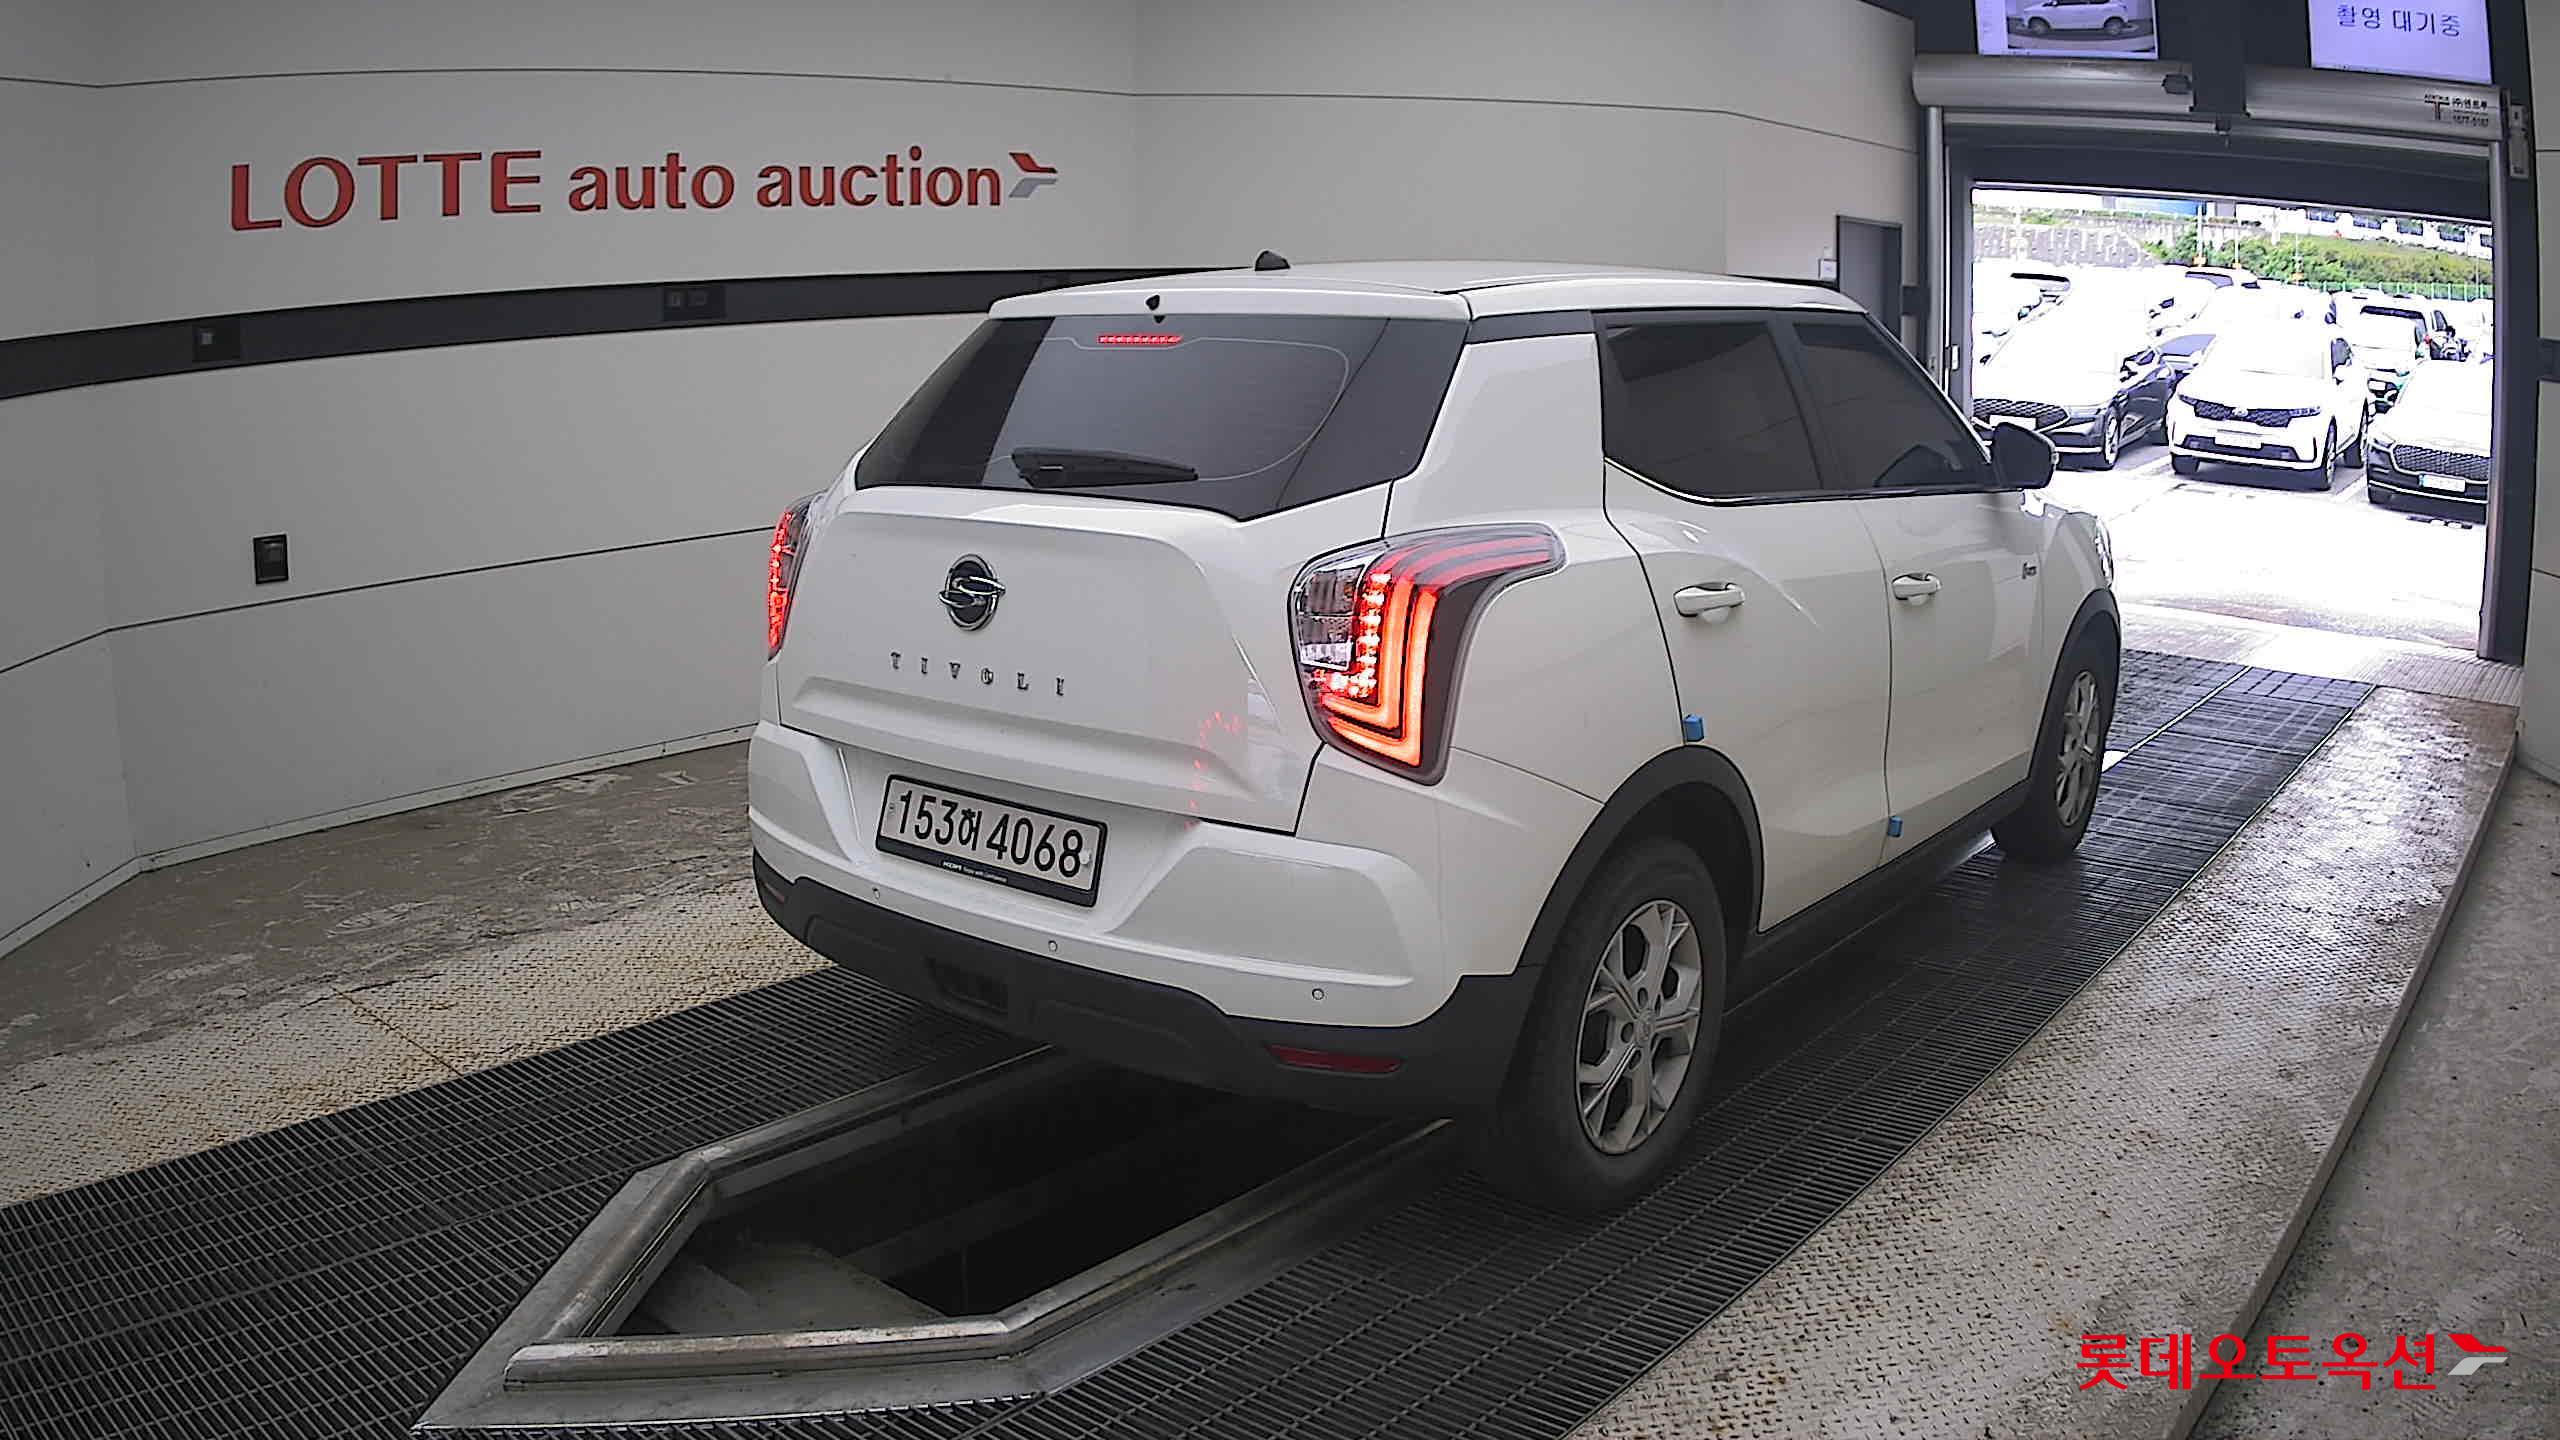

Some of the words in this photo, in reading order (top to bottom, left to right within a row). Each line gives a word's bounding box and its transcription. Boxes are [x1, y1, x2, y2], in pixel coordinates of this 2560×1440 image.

[2337, 4, 2382, 30] 촬영
[2392, 8, 2461, 38] 대기중
[230, 150, 541, 231] LOTTE
[567, 153, 736, 211] auto
[755, 146, 1002, 208] auction
[889, 651, 1065, 697] TIVOLI
